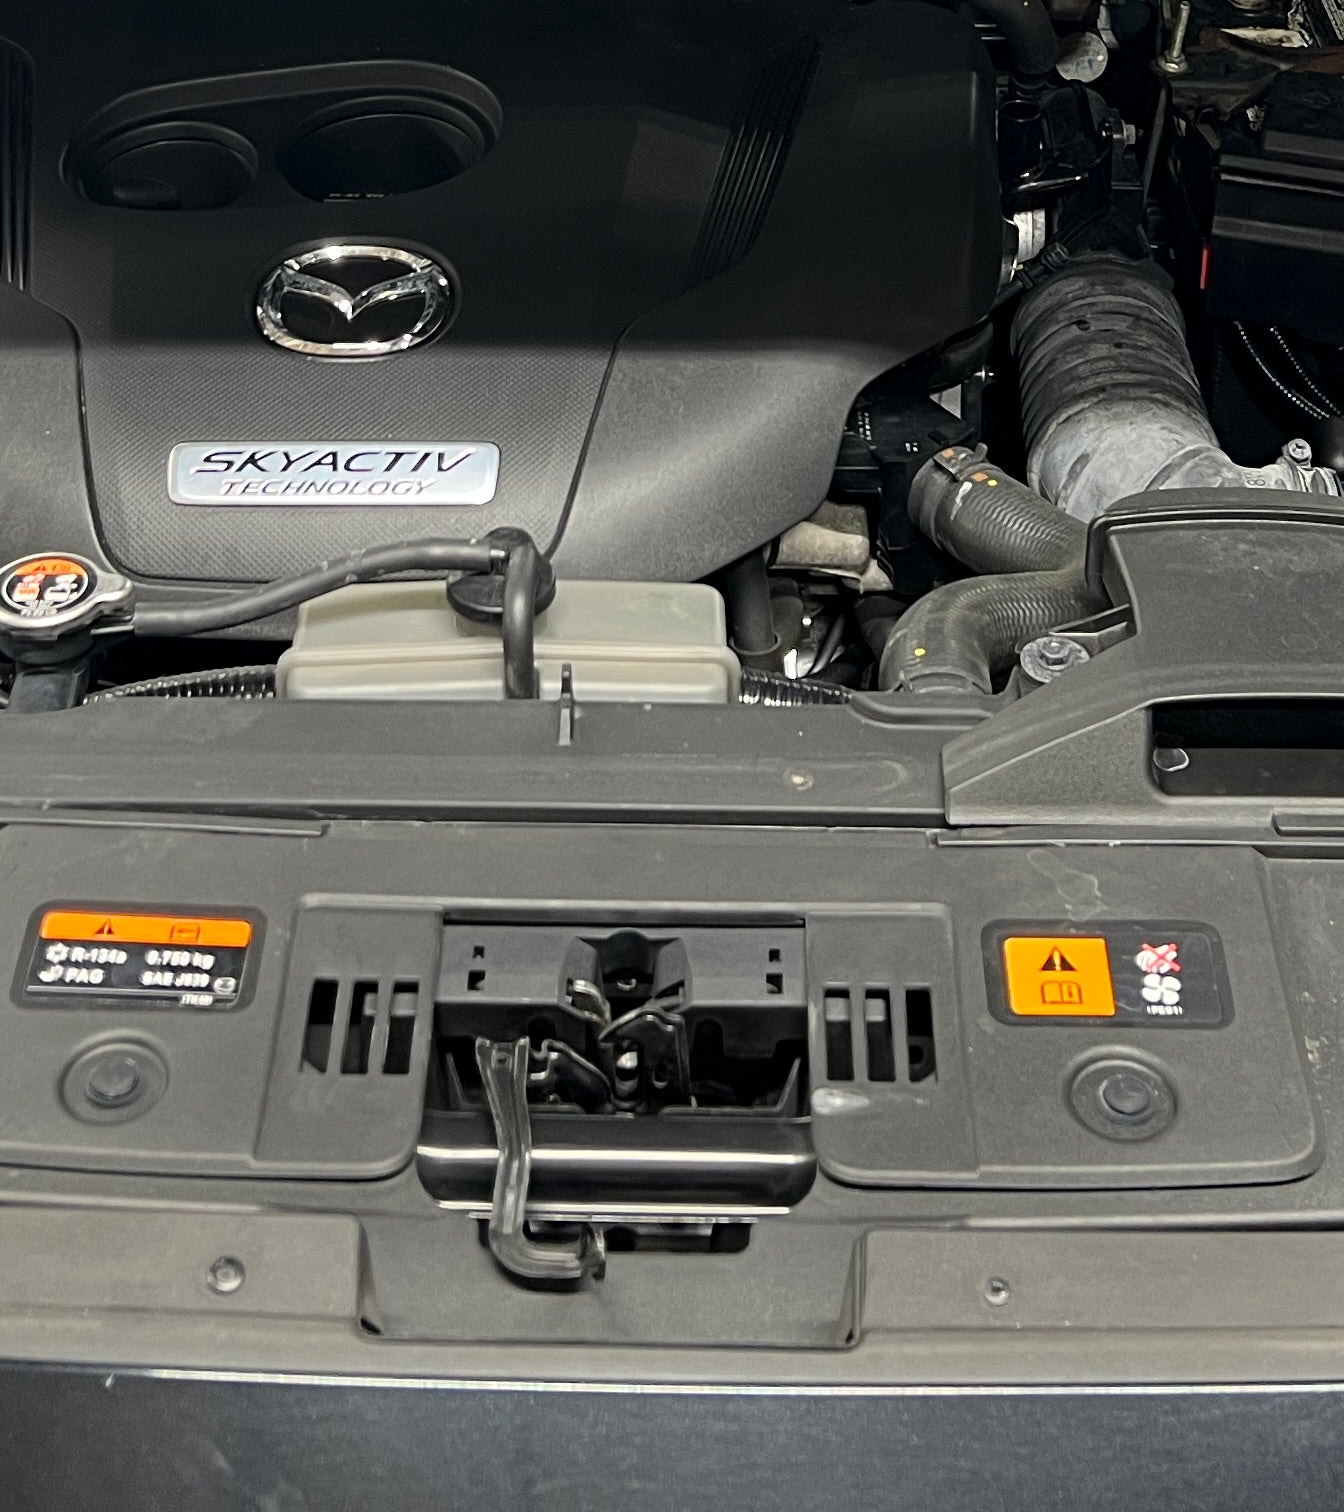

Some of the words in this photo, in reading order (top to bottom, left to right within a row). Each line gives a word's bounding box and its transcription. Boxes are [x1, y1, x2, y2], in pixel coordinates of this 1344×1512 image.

[191, 447, 476, 475] SKYACTIV
[220, 478, 438, 497] TECHNOLOGY
[64, 968, 105, 985] PAG
